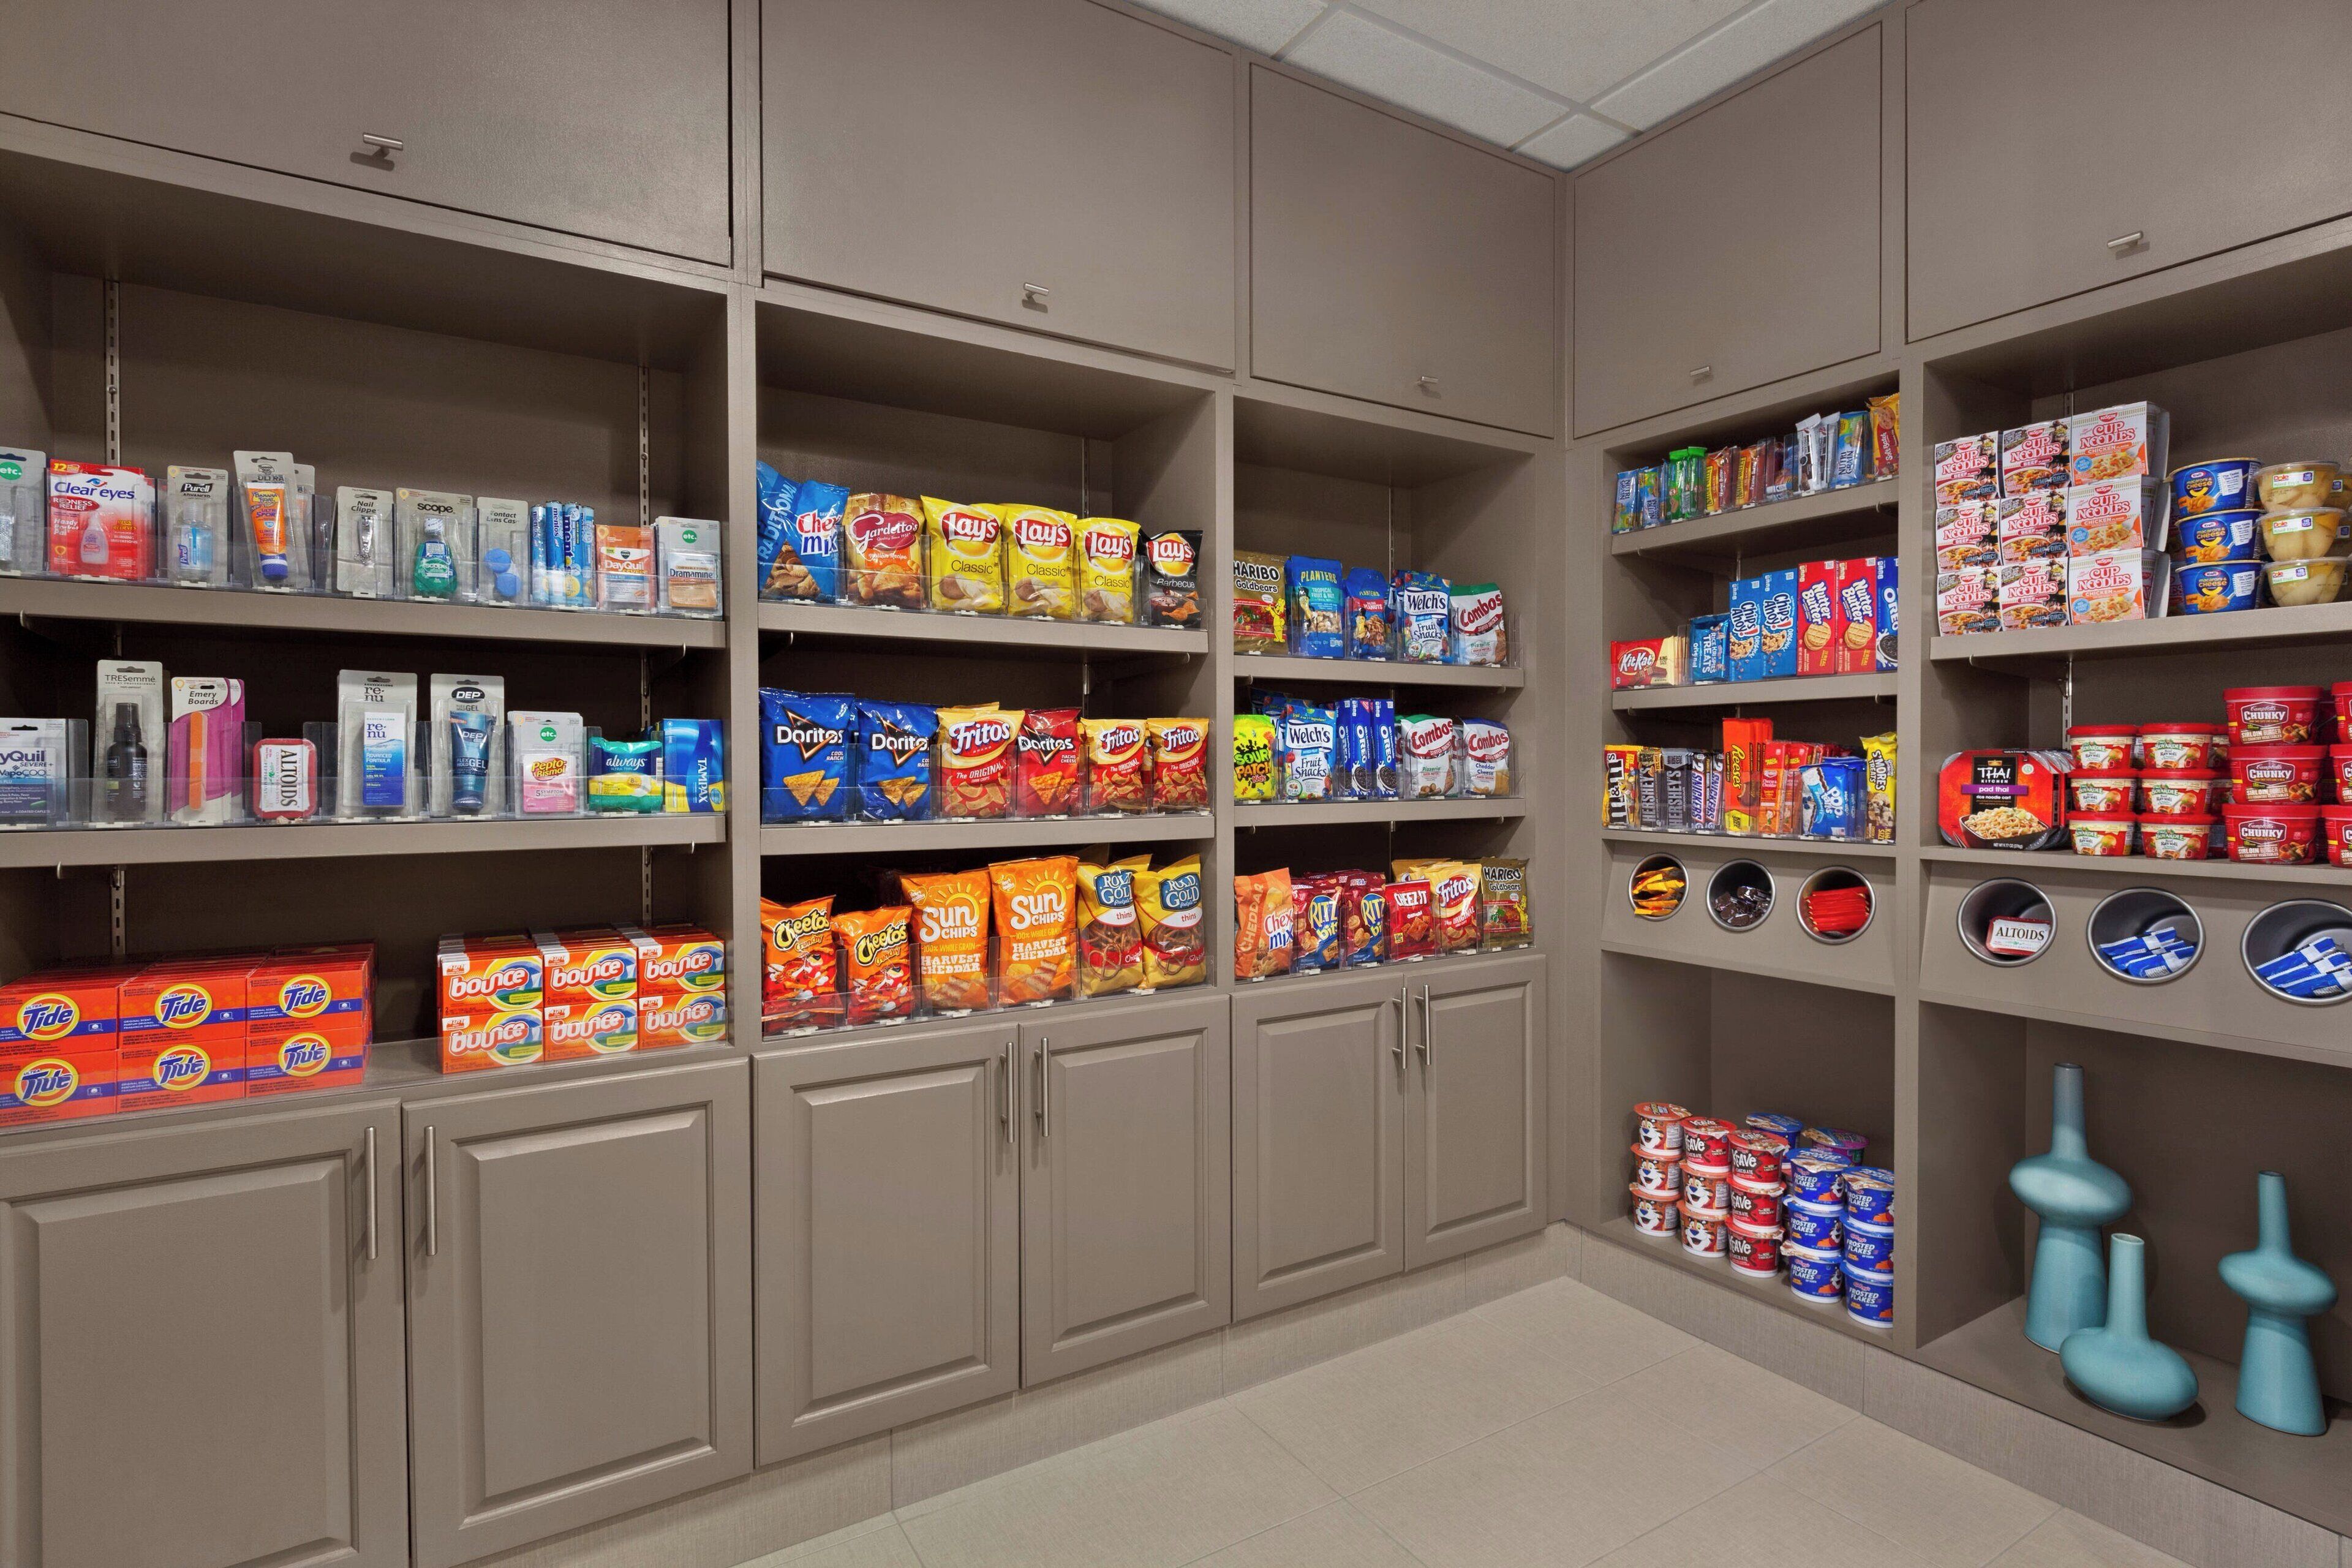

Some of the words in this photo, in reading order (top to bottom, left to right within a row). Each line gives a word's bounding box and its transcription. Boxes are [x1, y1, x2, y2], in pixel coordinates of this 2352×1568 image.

[2093, 421, 2125, 436] CUP
[2080, 428, 2136, 449] NOODLES
[2088, 445, 2116, 454] CHICKEN
[53, 463, 67, 472] 12
[55, 481, 97, 496] Clear
[99, 488, 135, 500] eyes
[53, 497, 92, 506] REDNESS
[417, 503, 454, 514] scope
[2089, 494, 2120, 508] CUP
[2076, 501, 2131, 520] NOODLES
[949, 513, 998, 542] Lay's
[1020, 519, 1068, 546] Lay's
[1090, 532, 1132, 559] Lay's
[604, 559, 644, 570] DayQuil
[951, 559, 993, 575] Classic
[1027, 564, 1066, 576] Classic
[1234, 560, 1280, 581] HARIBO
[2089, 566, 2120, 579] CUP
[669, 568, 714, 579] Dramamine
[1094, 575, 1129, 588] Classic
[1301, 570, 1338, 584] PLANTERS
[1236, 580, 1278, 593] Goldbears
[2078, 574, 2132, 592] NOODLES
[1407, 594, 1446, 610] Welch's
[1812, 582, 1831, 619] Nutter
[1842, 587, 1864, 623] Butter
[1853, 579, 1873, 617] Nutter
[1460, 594, 1502, 627] Combos
[1802, 589, 1822, 625] Butter
[1417, 623, 1436, 632] Fruit
[1414, 631, 1442, 641] Snacks
[1702, 635, 1711, 673] TREATS
[2243, 711, 2286, 720] CHUNKY
[1099, 725, 1140, 753] Fritos
[1161, 725, 1199, 752] Fritos
[1289, 727, 1330, 744] Welch's
[1411, 720, 1453, 750] Combos
[1356, 725, 1366, 763] OREO
[1381, 725, 1392, 763] OREO
[469, 758, 486, 768] GEL
[1234, 748, 1269, 765] SOUR
[1301, 758, 1322, 769] Fruit
[1235, 764, 1271, 777] PATCH
[1295, 767, 1327, 778] Snacks
[1732, 744, 1745, 789] Reese's
[1868, 759, 1877, 783] TREATS
[1977, 767, 2011, 779] THAI
[2248, 769, 2293, 779] CHUNKY
[281, 749, 298, 807] ALTOIDS
[698, 758, 708, 804] TAMPAX
[1667, 770, 1683, 826] HERSHEY'S
[1692, 772, 1703, 820] SNICKERS
[2241, 828, 2283, 838] CHUNKY
[1483, 867, 1521, 881] HARIBO
[1489, 883, 1521, 891] Goldbears
[1011, 892, 1066, 930] Sun
[1030, 911, 1065, 925] CHIPS
[1116, 911, 1133, 920] thins
[1181, 913, 1197, 922] thins
[1240, 883, 1264, 952] CHEDDAR
[1309, 900, 1338, 927] RITZ
[919, 905, 979, 943] Sun
[941, 926, 978, 940] CHIPS
[1031, 930, 1047, 938] WHOLE
[1047, 927, 1063, 937] GRAIN
[1996, 926, 2045, 942] ALTOIDS
[940, 943, 957, 952] WHOLE
[1012, 937, 1067, 952] HARVEST
[646, 953, 712, 979] bounce
[921, 953, 981, 964] HARVEST
[552, 961, 624, 987] bounce
[451, 968, 529, 997] bounce
[282, 987, 327, 1012] Tide
[160, 997, 207, 1023] Tide
[21, 1009, 72, 1034] Tide
[1793, 1171, 1817, 1183] FROSTED
[1848, 1245, 1872, 1255] FLAKES
[1849, 1287, 1879, 1299] FROSTED
[1850, 1294, 1877, 1303] FLAKES
